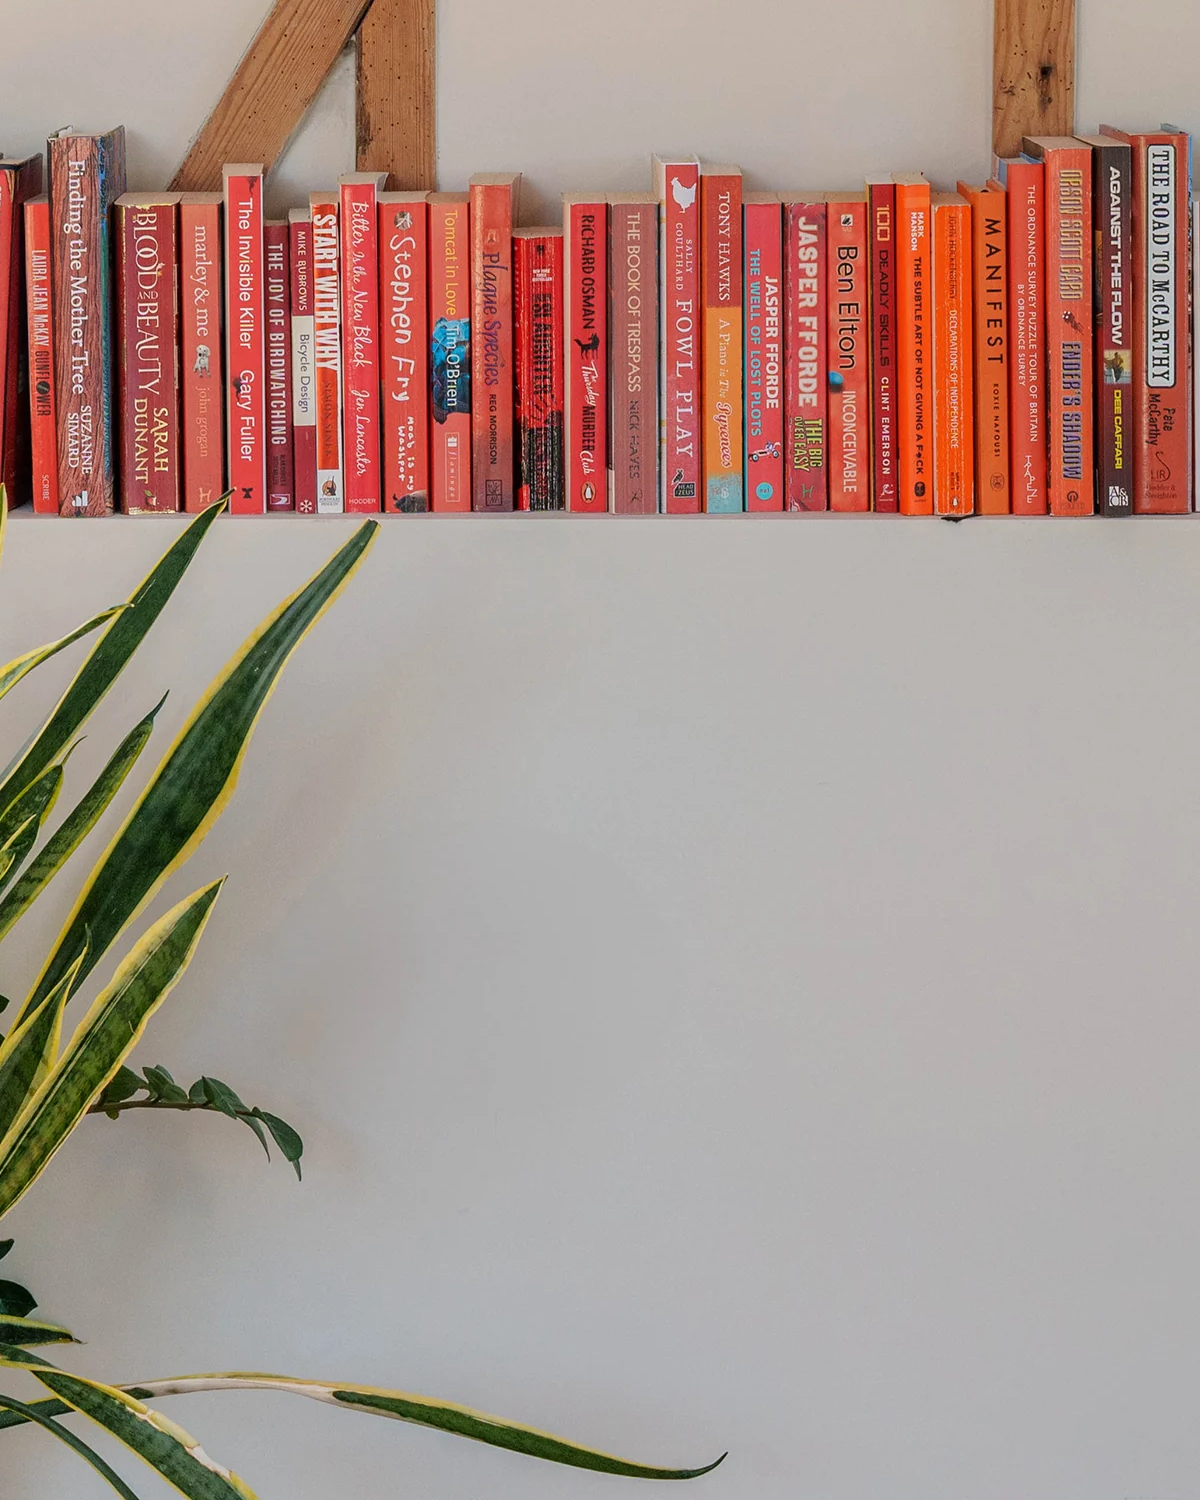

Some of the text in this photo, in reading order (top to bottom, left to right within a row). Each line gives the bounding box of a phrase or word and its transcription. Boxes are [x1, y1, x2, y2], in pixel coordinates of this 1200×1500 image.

[64, 160, 89, 394] Finding the Mother Tree
[133, 213, 158, 290] BLOOD
[190, 226, 212, 337] marley & me
[268, 243, 283, 270] THE
[297, 231, 307, 311] MIKE BURROWS
[445, 210, 458, 315] Tomcat in Love
[675, 223, 683, 290] COULTHARD
[718, 192, 730, 301] TONY HAWKS
[837, 246, 858, 292] Ben
[1059, 169, 1083, 301] ORSON SCOTT CARD
[1110, 166, 1122, 345] AGAINST THE FLOW
[1152, 151, 1170, 381] THE ROAD TO McCARTHY
[32, 250, 49, 346] LAURA JEAN McKAY
[238, 198, 255, 461] The Invisible Killer Gary Fuller
[268, 277, 283, 302] JOY
[269, 309, 284, 326] OF
[313, 214, 338, 371] START WITH WHY
[389, 235, 416, 401] Stephen Fry
[477, 251, 508, 386] Plague Species
[627, 212, 641, 392] THE BOOK OF TRESPASS
[798, 217, 818, 407] JASPER FFORDE
[876, 204, 890, 366] 100 DEADLY SKILLS
[914, 281, 922, 321] SUBTLE
[987, 218, 1002, 364] MANIFEST
[1027, 185, 1038, 442] THE ORDNANCE SURVEY PUZZLE TOUR OF BRITAIN
[136, 302, 161, 395] BEAUTY
[298, 334, 310, 413] Bicycle Design
[351, 201, 372, 476] Bitter Is the New Black Jen Lancaster
[446, 325, 460, 406] Tim O'Brien
[676, 299, 693, 457] FOWL PLAY
[750, 249, 761, 436] THE WELL OF LOST PLOTS
[765, 276, 778, 408] JASPER FFORDE
[838, 303, 860, 369] Elton
[914, 324, 922, 345] ART
[915, 349, 923, 364] OF
[915, 368, 923, 388] NOT
[1017, 284, 1026, 386] BY ORDNANCE SURVEY
[269, 332, 286, 444] BIRDWATCHING
[324, 382, 333, 418] SIMON
[489, 394, 497, 464] REG MORRISON
[579, 360, 599, 475] Thursday MURDER Club
[881, 377, 890, 474] CLINT EMERSON
[1114, 390, 1122, 469] DEE CAFFARI
[1146, 394, 1161, 446] McCarthy
[1163, 408, 1176, 431] Pete
[68, 413, 79, 468] SIMARD
[80, 406, 92, 474] SUZANNE
[134, 398, 149, 484] DUNANT
[150, 407, 168, 472] SARAH
[794, 416, 810, 472] OVER EASY
[804, 419, 823, 467] THE BIG
[842, 391, 857, 492] INCONCEIVABLE
